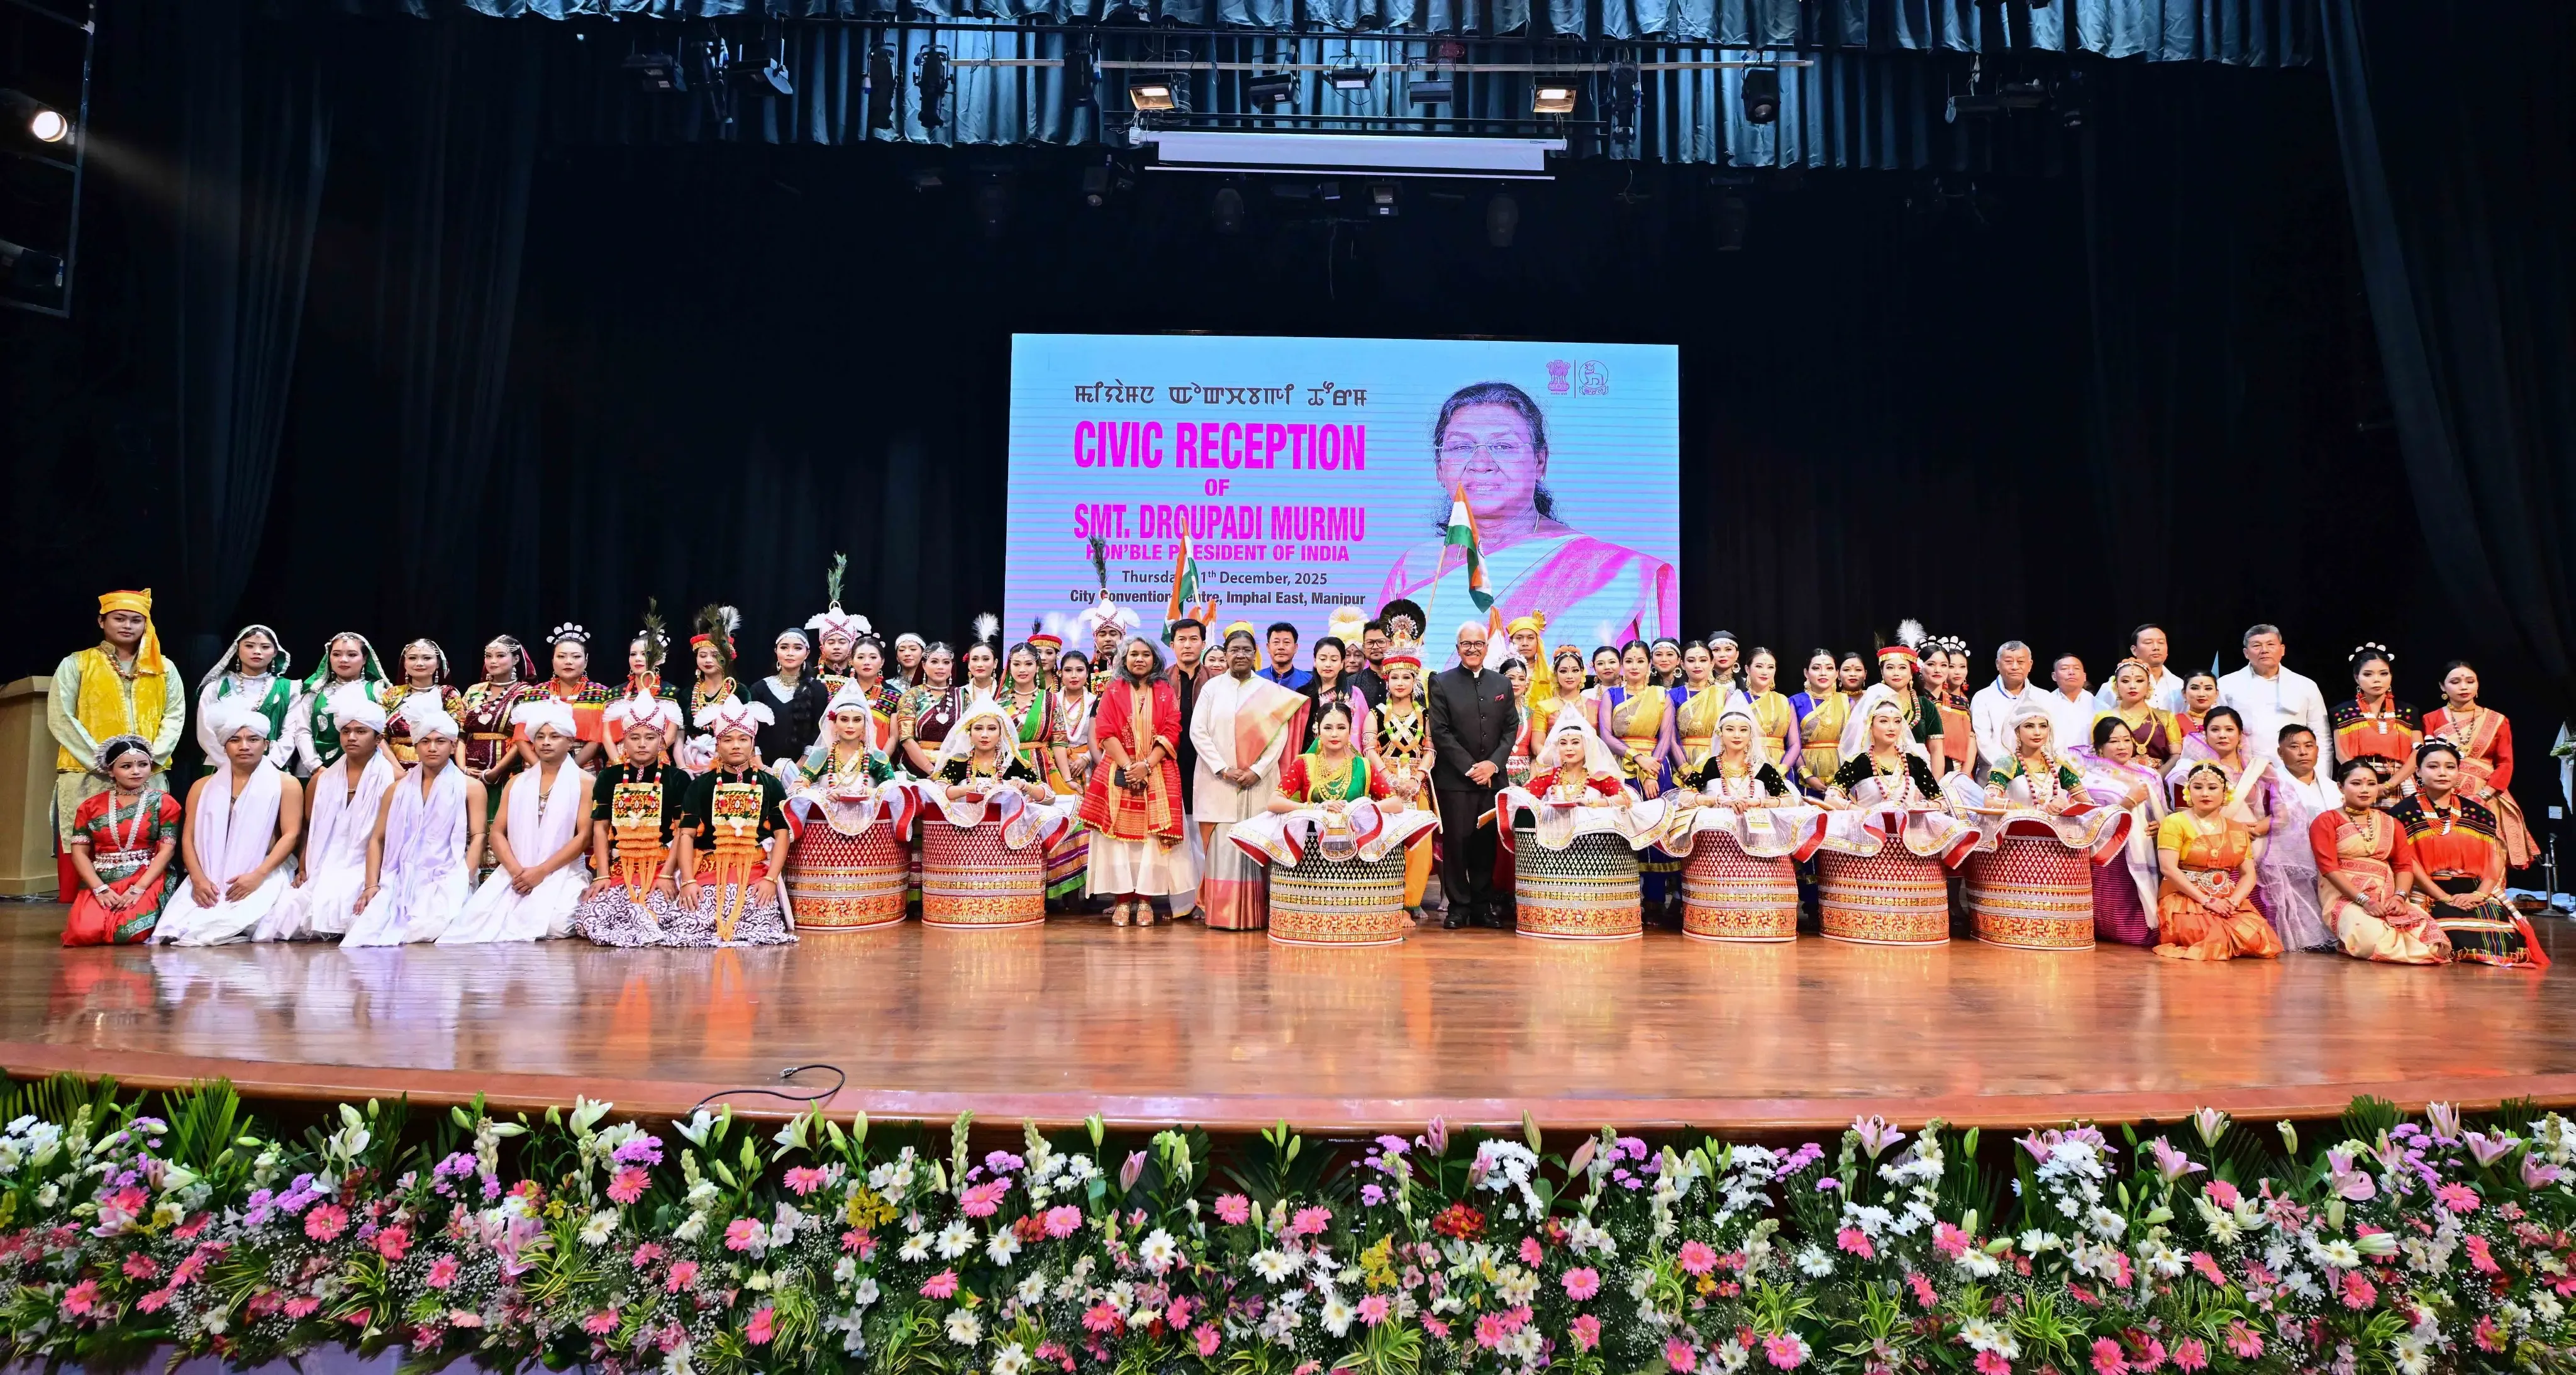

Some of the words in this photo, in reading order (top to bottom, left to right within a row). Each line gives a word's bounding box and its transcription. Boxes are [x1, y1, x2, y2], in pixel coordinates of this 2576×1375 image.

[1074, 421, 1163, 468] CIVIC
[1176, 422, 1365, 470] RECEPTION
[1204, 479, 1230, 496] OF
[1074, 503, 1130, 538] SMT.
[1140, 504, 1262, 540] DROUPADI
[1271, 506, 1365, 542] MURMU
[1169, 544, 1267, 560] PESIDENT
[1273, 545, 1295, 561] OF
[1301, 545, 1350, 562] INDIA
[1122, 570, 1175, 583] Thursda
[1201, 570, 1216, 583] 1th
[1220, 571, 1291, 586] December,
[1294, 572, 1327, 585] 2025
[1070, 589, 1096, 604] City
[1185, 591, 1223, 606] entre,
[1227, 591, 1271, 606] Imphal
[1275, 592, 1307, 606] East,
[1311, 592, 1366, 607] Manipur
